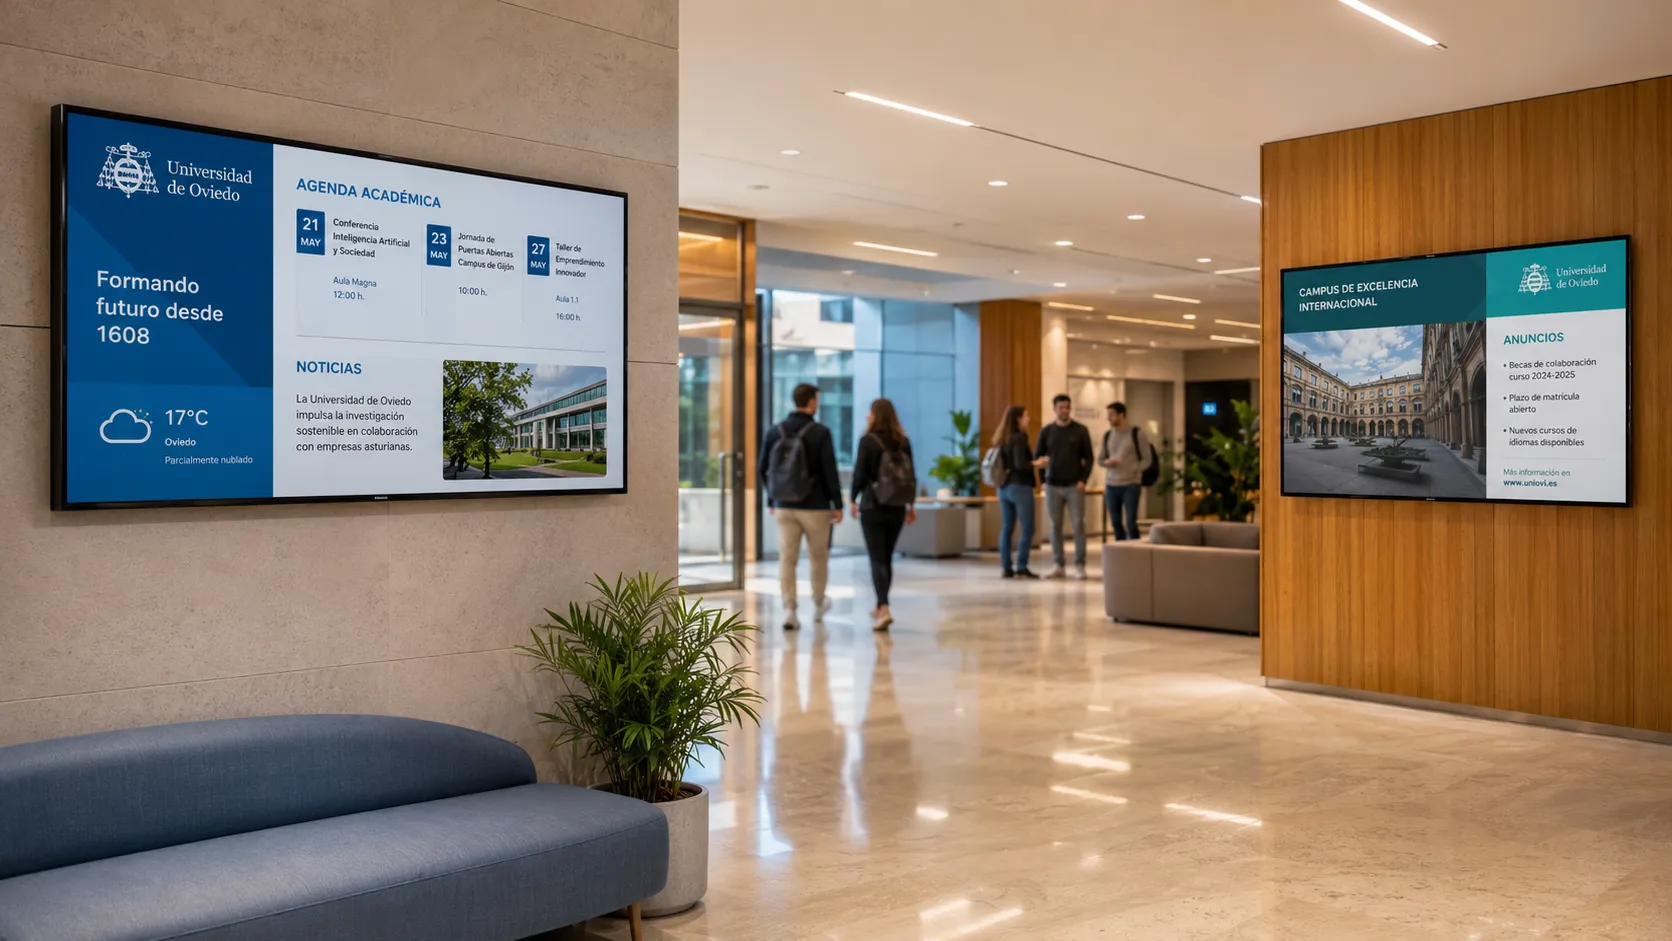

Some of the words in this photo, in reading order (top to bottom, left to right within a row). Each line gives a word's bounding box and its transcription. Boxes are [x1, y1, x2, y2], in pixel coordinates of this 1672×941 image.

[167, 160, 252, 184] Universidad
[167, 180, 186, 195] de
[189, 184, 240, 202] Oviedo
[297, 178, 357, 197] AGENDA
[361, 187, 441, 208] ACADÉMICA
[303, 218, 318, 231] 21
[333, 218, 379, 230] Conferencia
[301, 238, 320, 246] MAY
[333, 232, 377, 244] Inteligencia
[379, 238, 410, 247] Artificial
[432, 232, 447, 244] 23
[458, 233, 485, 242] Jornada
[340, 247, 376, 257] Sociedad
[458, 245, 484, 255] Puertas
[486, 249, 514, 258] Abiertas
[532, 243, 545, 255] 27
[556, 243, 572, 251] Taller
[430, 251, 448, 259] MAY
[458, 259, 485, 269] Campus
[497, 263, 514, 271] Gijón
[531, 261, 546, 269] MAY
[1556, 264, 1607, 276] Universidad
[97, 270, 199, 294] Formando
[333, 277, 350, 285] Aula
[352, 278, 377, 288] Magna
[1299, 285, 1339, 297] CAMPUS
[1342, 284, 1354, 293] DE
[1357, 278, 1418, 292] EXCELENCIA
[1556, 280, 1567, 288] de
[1568, 277, 1598, 287] Oviedo
[333, 291, 356, 299] 12:00
[459, 287, 479, 295] 10:00
[96, 297, 160, 318] futuro
[166, 302, 223, 322] desde
[1299, 297, 1377, 312] INTERNACIONAL
[97, 325, 150, 344] 1608
[1504, 332, 1564, 345] ANUNCIOS
[296, 360, 362, 374] NOTICIAS
[1546, 358, 1596, 367] colaboración
[1532, 371, 1575, 380] 2024-2025
[296, 394, 307, 403] La
[310, 395, 364, 405] Universidad
[367, 396, 378, 405] de
[380, 396, 411, 406] Oviedo
[165, 409, 208, 426] 17°C
[296, 410, 333, 421] impulsa
[336, 411, 343, 420] la
[346, 411, 404, 422] investigación
[296, 426, 344, 436] sostenible
[361, 427, 418, 436] colaboración
[165, 438, 196, 446] Oviedo
[317, 444, 362, 453] empresas
[364, 442, 412, 451] asturianas.
[1540, 439, 1584, 447] disponibles
[165, 456, 219, 464] Parcialmente
[221, 456, 253, 464] nublado
